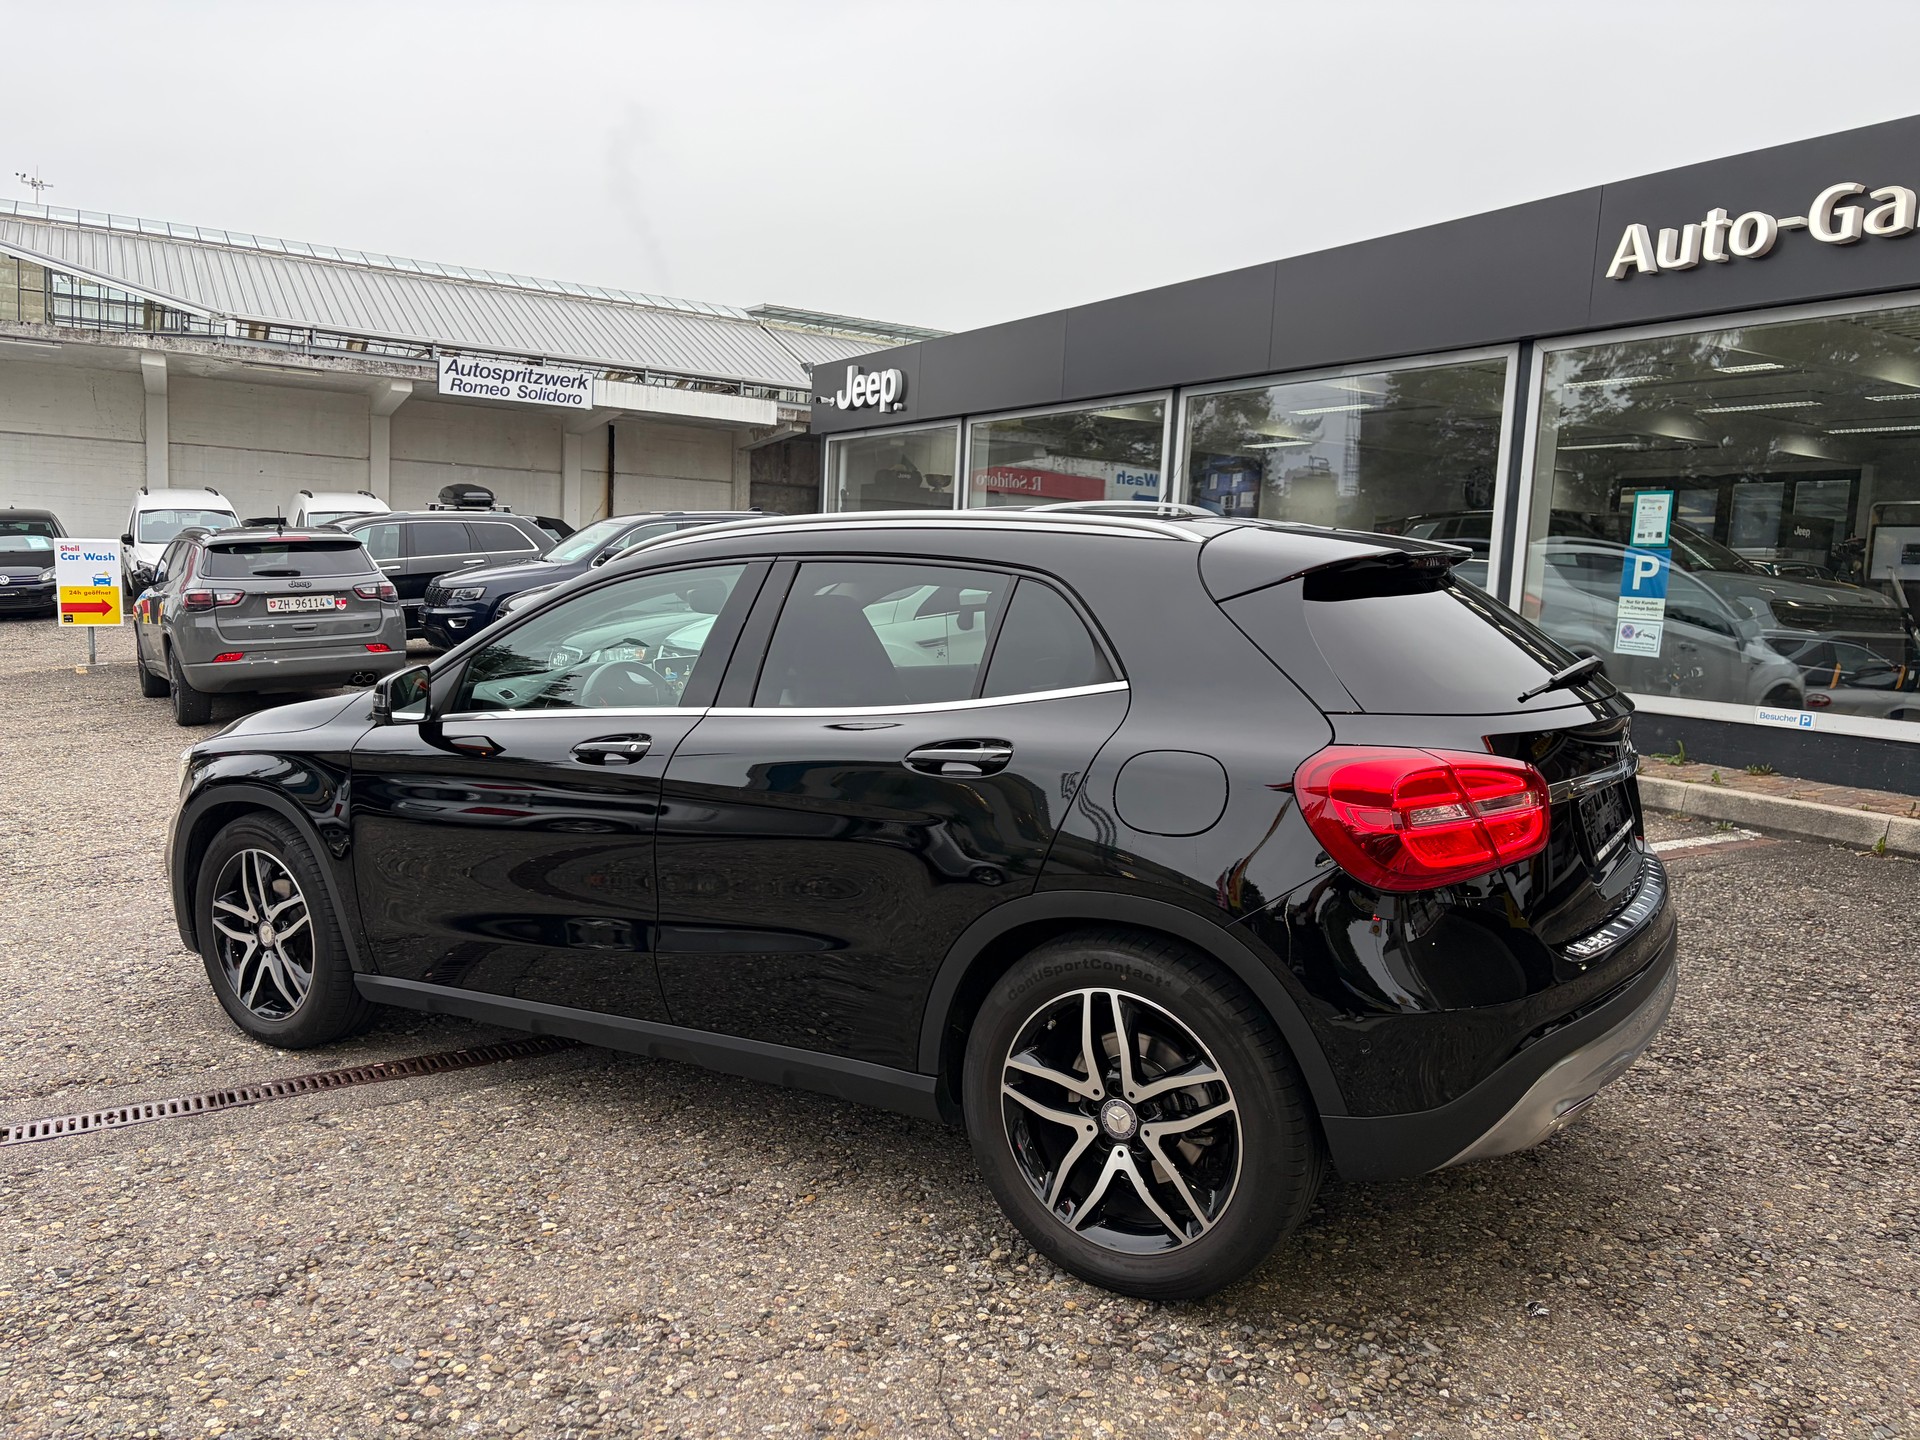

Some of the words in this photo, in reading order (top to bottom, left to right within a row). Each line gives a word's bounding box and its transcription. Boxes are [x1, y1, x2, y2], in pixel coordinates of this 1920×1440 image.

[1605, 181, 1920, 280] Auto-Ga
[444, 358, 589, 390] Autospritzwerk
[450, 377, 511, 397] Romeo
[516, 385, 583, 405] Solidoro
[836, 365, 903, 413] Jeep
[1793, 525, 1811, 538] Jeep
[60, 552, 80, 561] Car
[83, 552, 116, 561] Wash
[288, 580, 312, 588] Jeep
[1632, 555, 1660, 590] P
[1760, 711, 1798, 723] Besucher
